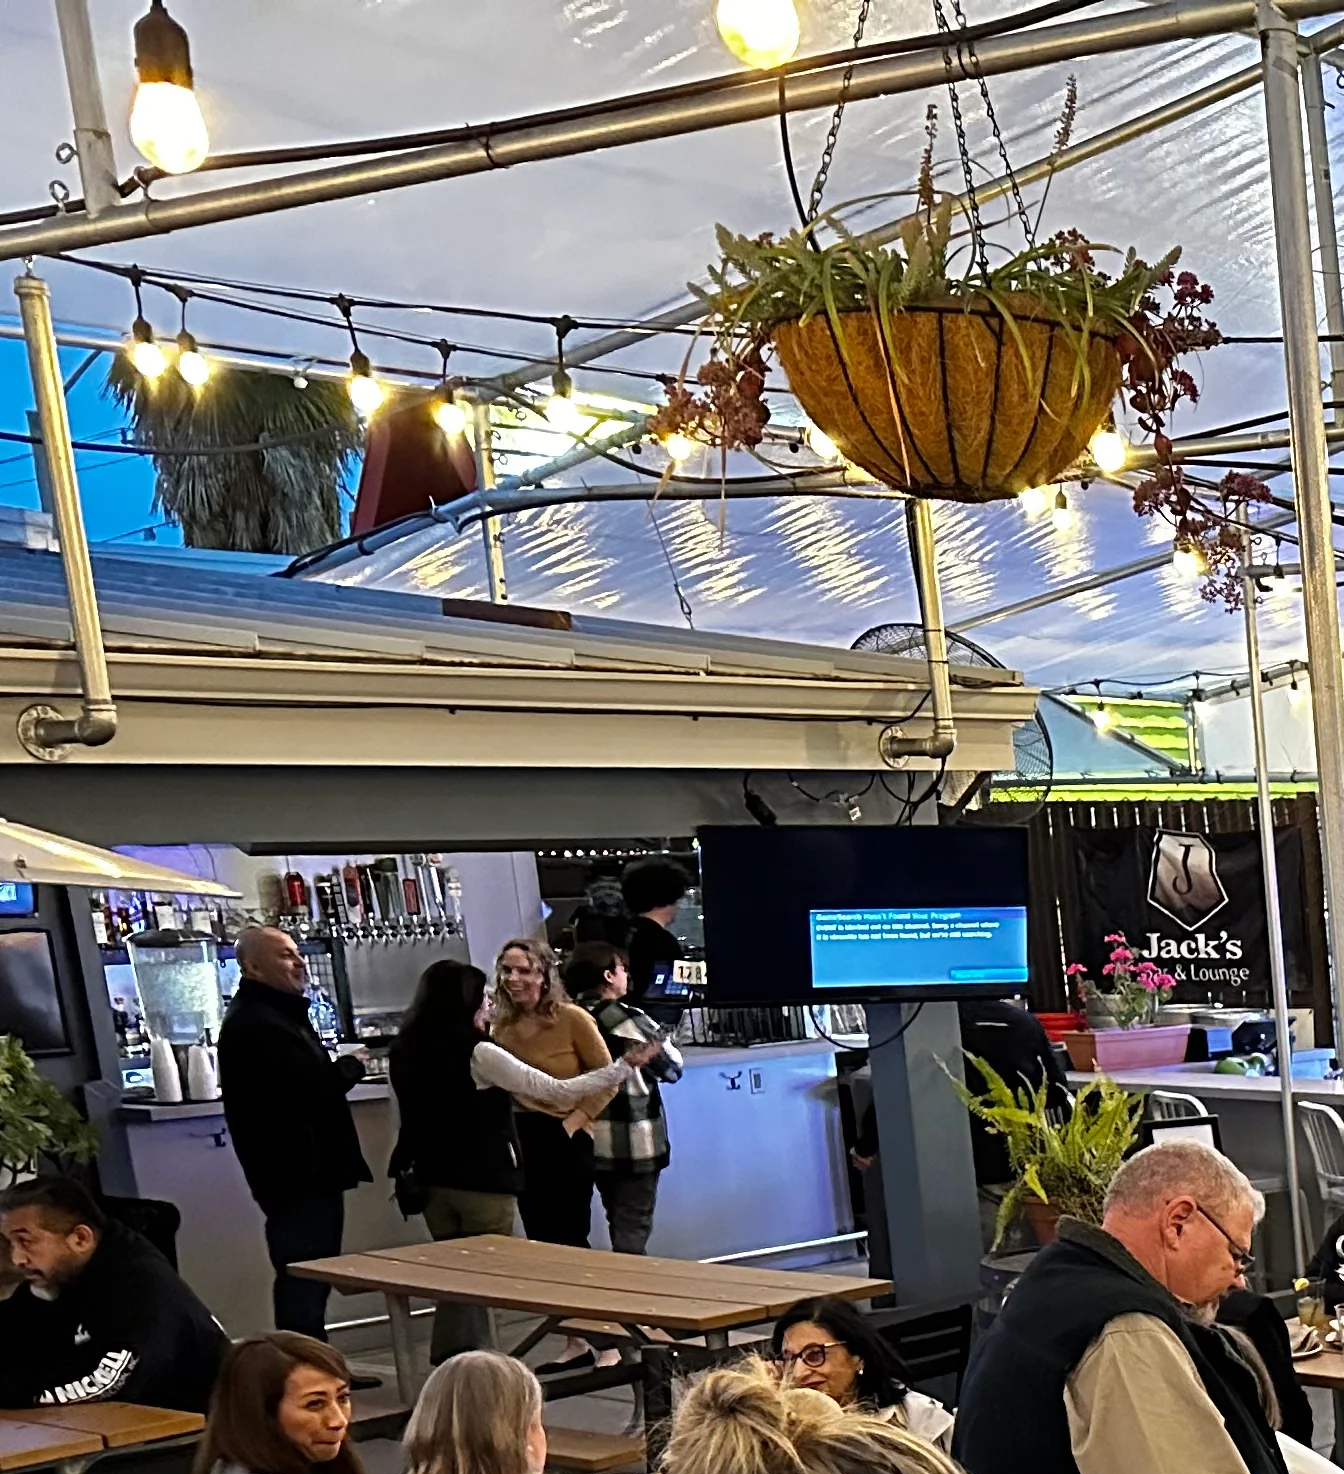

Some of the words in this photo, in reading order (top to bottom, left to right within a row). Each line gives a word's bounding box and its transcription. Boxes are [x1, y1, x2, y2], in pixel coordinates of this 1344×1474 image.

[1140, 930, 1243, 960] Jack's
[1174, 963, 1187, 981] &
[1190, 963, 1250, 986] Lounge
